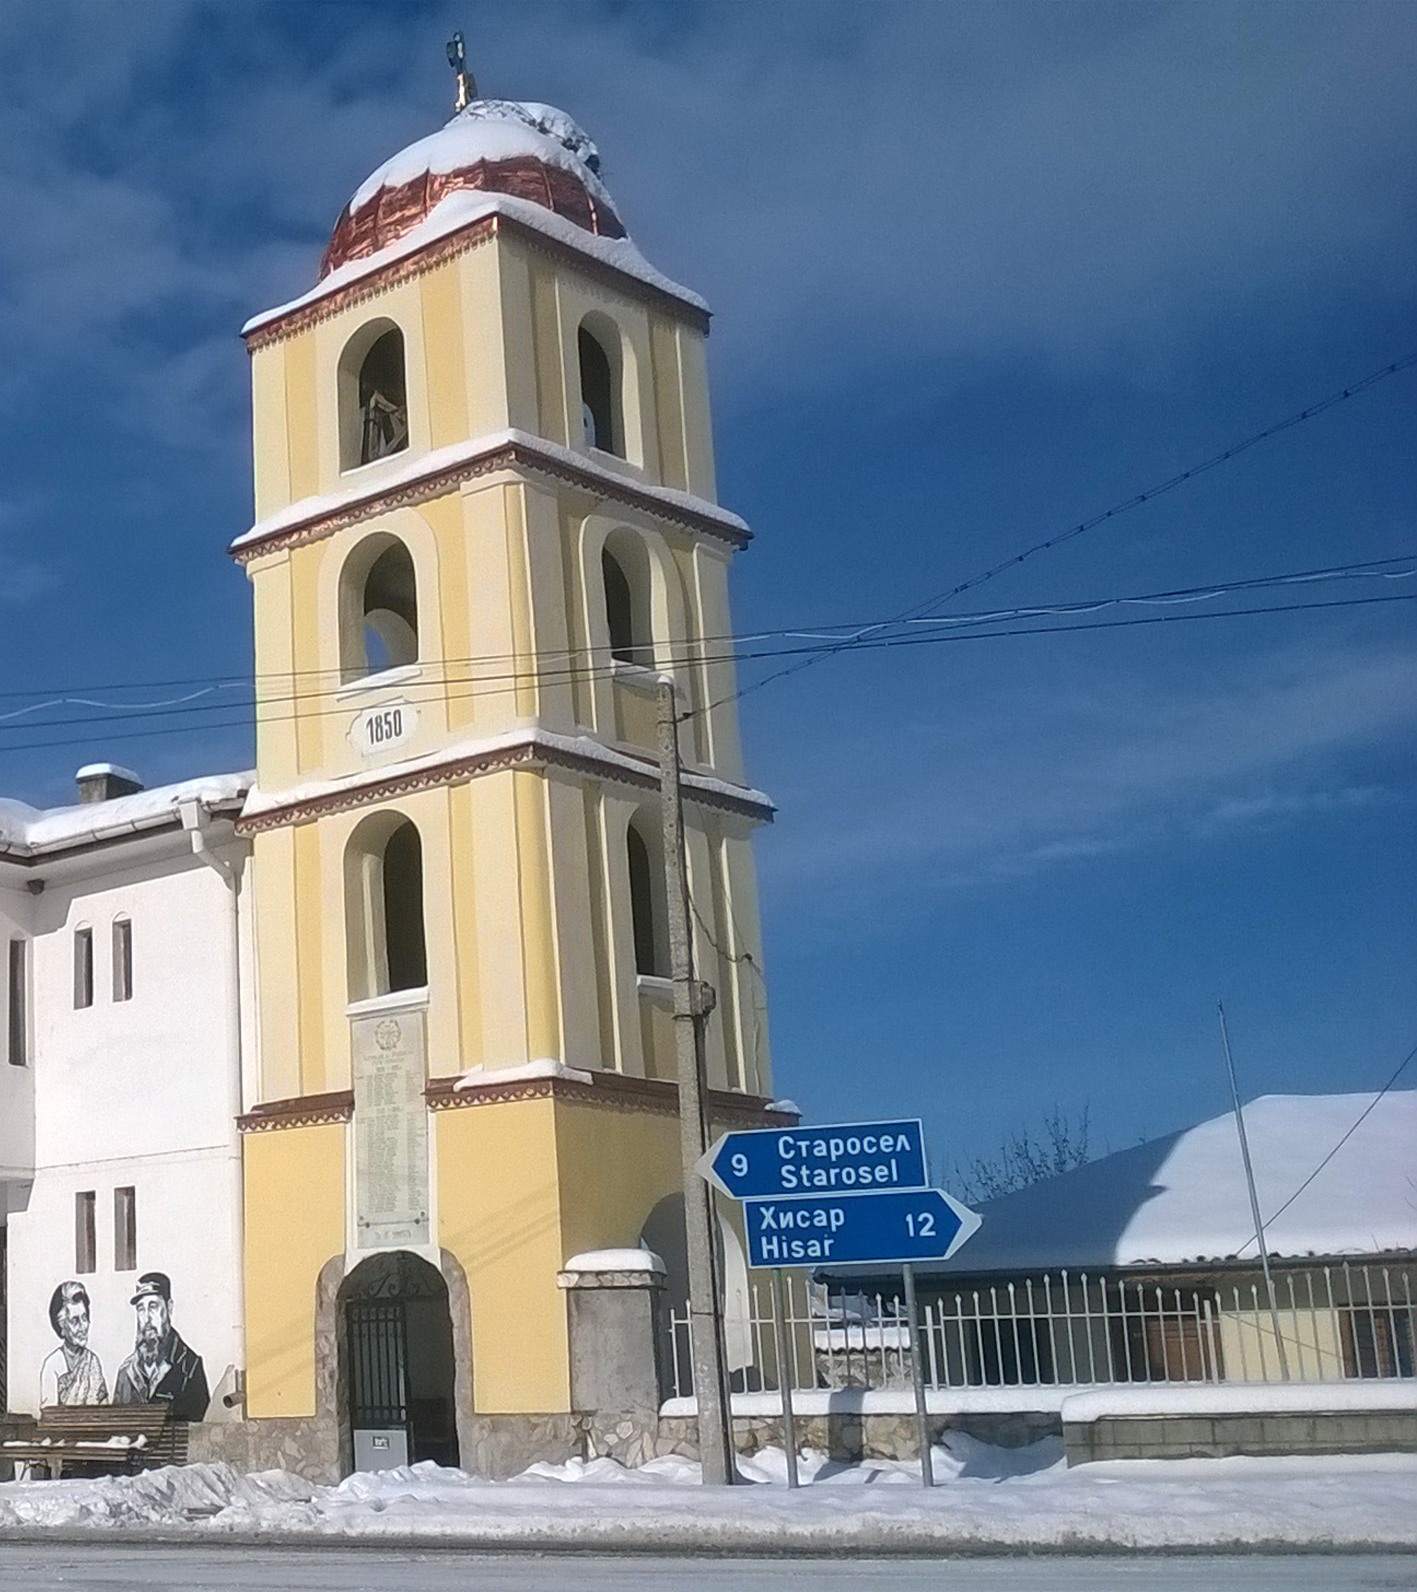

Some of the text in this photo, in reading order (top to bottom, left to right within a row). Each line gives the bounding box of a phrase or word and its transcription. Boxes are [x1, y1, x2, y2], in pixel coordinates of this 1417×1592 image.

[366, 709, 402, 745] 1850
[778, 1134, 911, 1161] Старосел
[731, 1153, 748, 1177] 9
[781, 1159, 898, 1188] Starosel
[759, 1206, 845, 1232] Хисар
[905, 1212, 936, 1237] 12
[761, 1235, 834, 1260] Hisar
